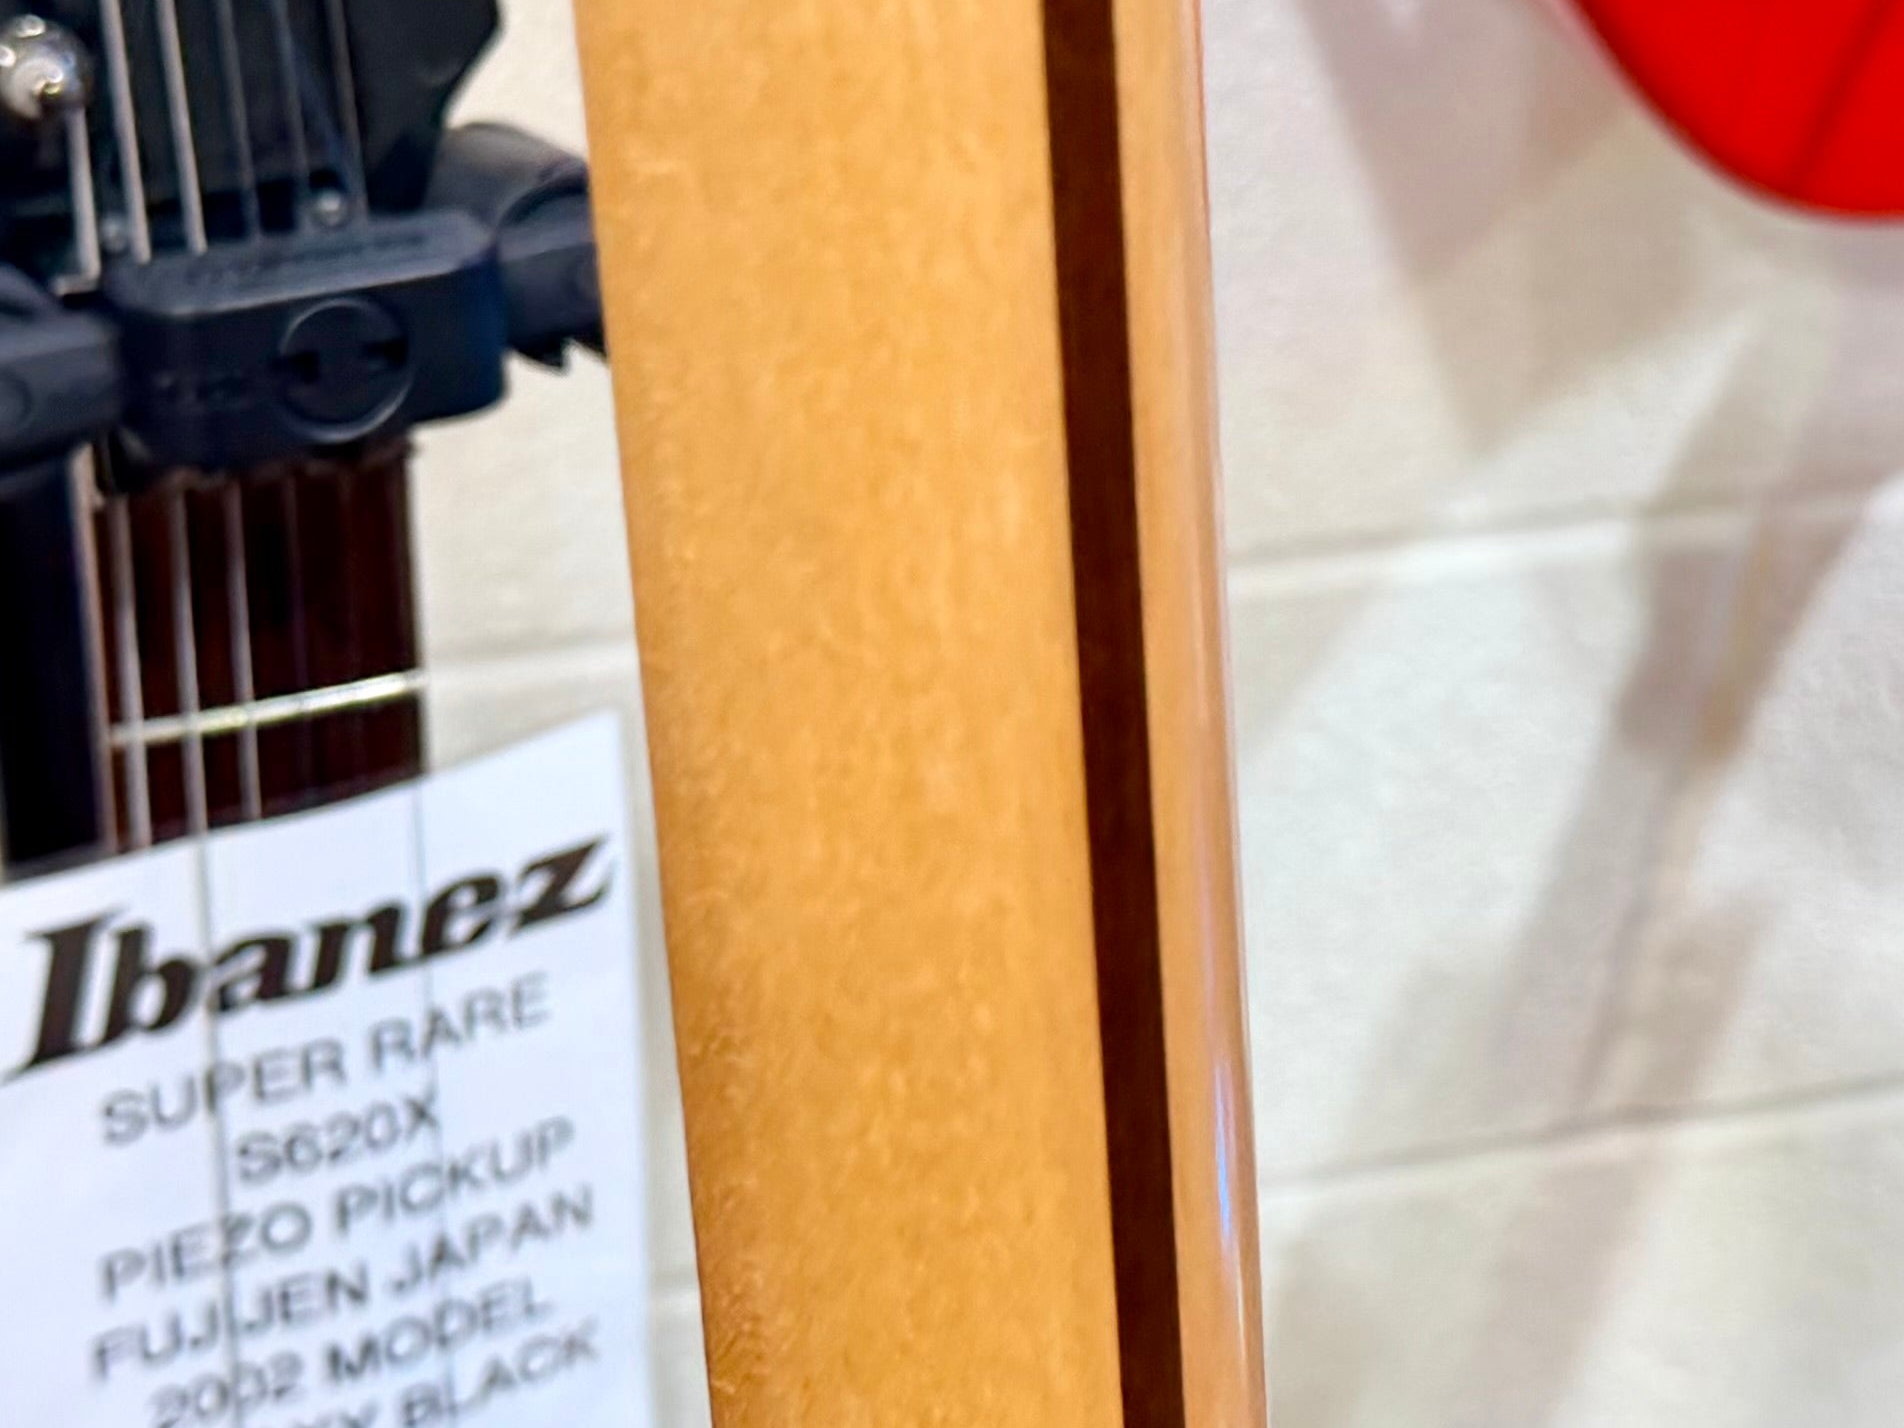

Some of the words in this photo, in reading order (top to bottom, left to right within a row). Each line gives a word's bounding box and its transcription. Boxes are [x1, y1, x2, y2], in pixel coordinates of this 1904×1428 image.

[0, 836, 616, 1087] Ibanez
[102, 1036, 346, 1146] SUPER
[370, 969, 551, 1071] RARE
[100, 1202, 313, 1301] PIEZO
[333, 1115, 576, 1235] PICKUP
[236, 1088, 441, 1186] S620X
[390, 1184, 594, 1295] JAPAN
[324, 1275, 553, 1383] MODEL
